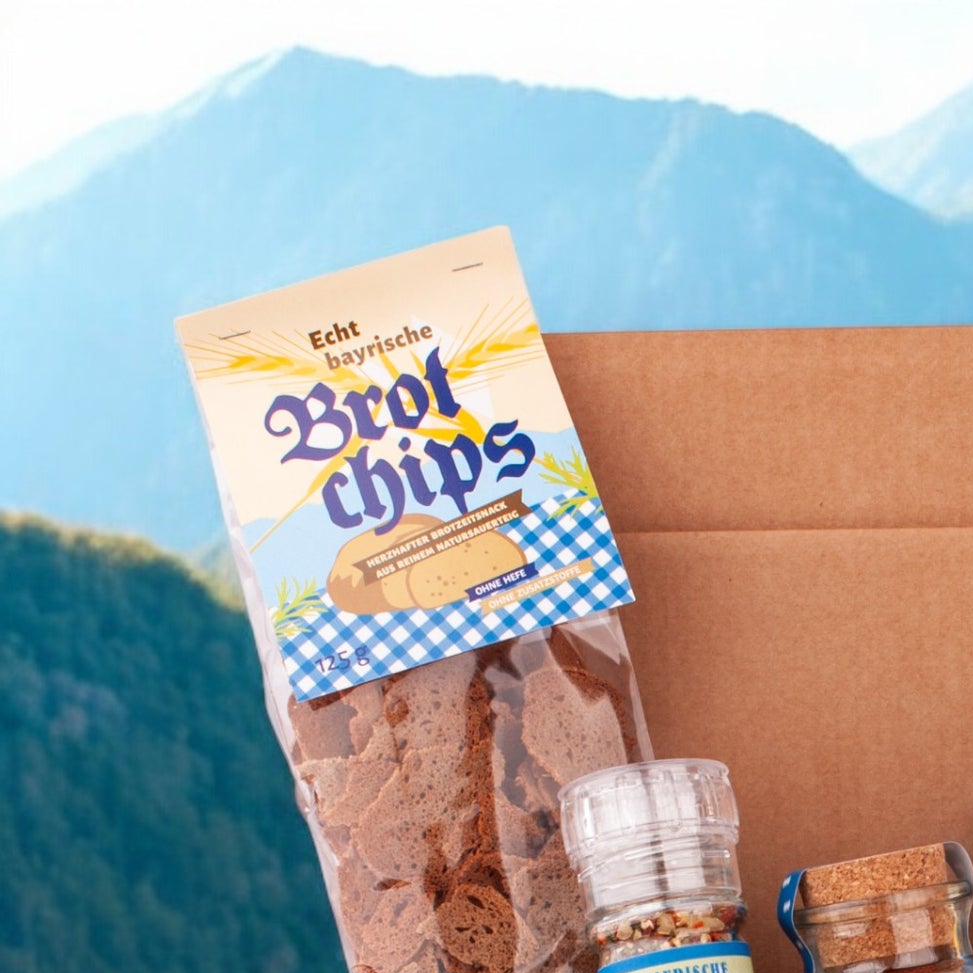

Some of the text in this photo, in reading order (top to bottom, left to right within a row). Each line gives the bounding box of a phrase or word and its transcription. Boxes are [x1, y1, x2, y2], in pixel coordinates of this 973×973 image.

[308, 320, 360, 351] Echt
[324, 323, 433, 370] bayrische
[263, 347, 462, 464] Brot
[321, 419, 536, 535] chips
[367, 501, 508, 569] HERZHAFTER BROTZEITSNACK
[376, 509, 520, 579] AUS REINEM NATURSAUERTEIG
[475, 569, 527, 596] OHNE HEFE
[488, 565, 582, 609] OHNE ZUSATZSTOFFE
[315, 644, 371, 674] 125 g
